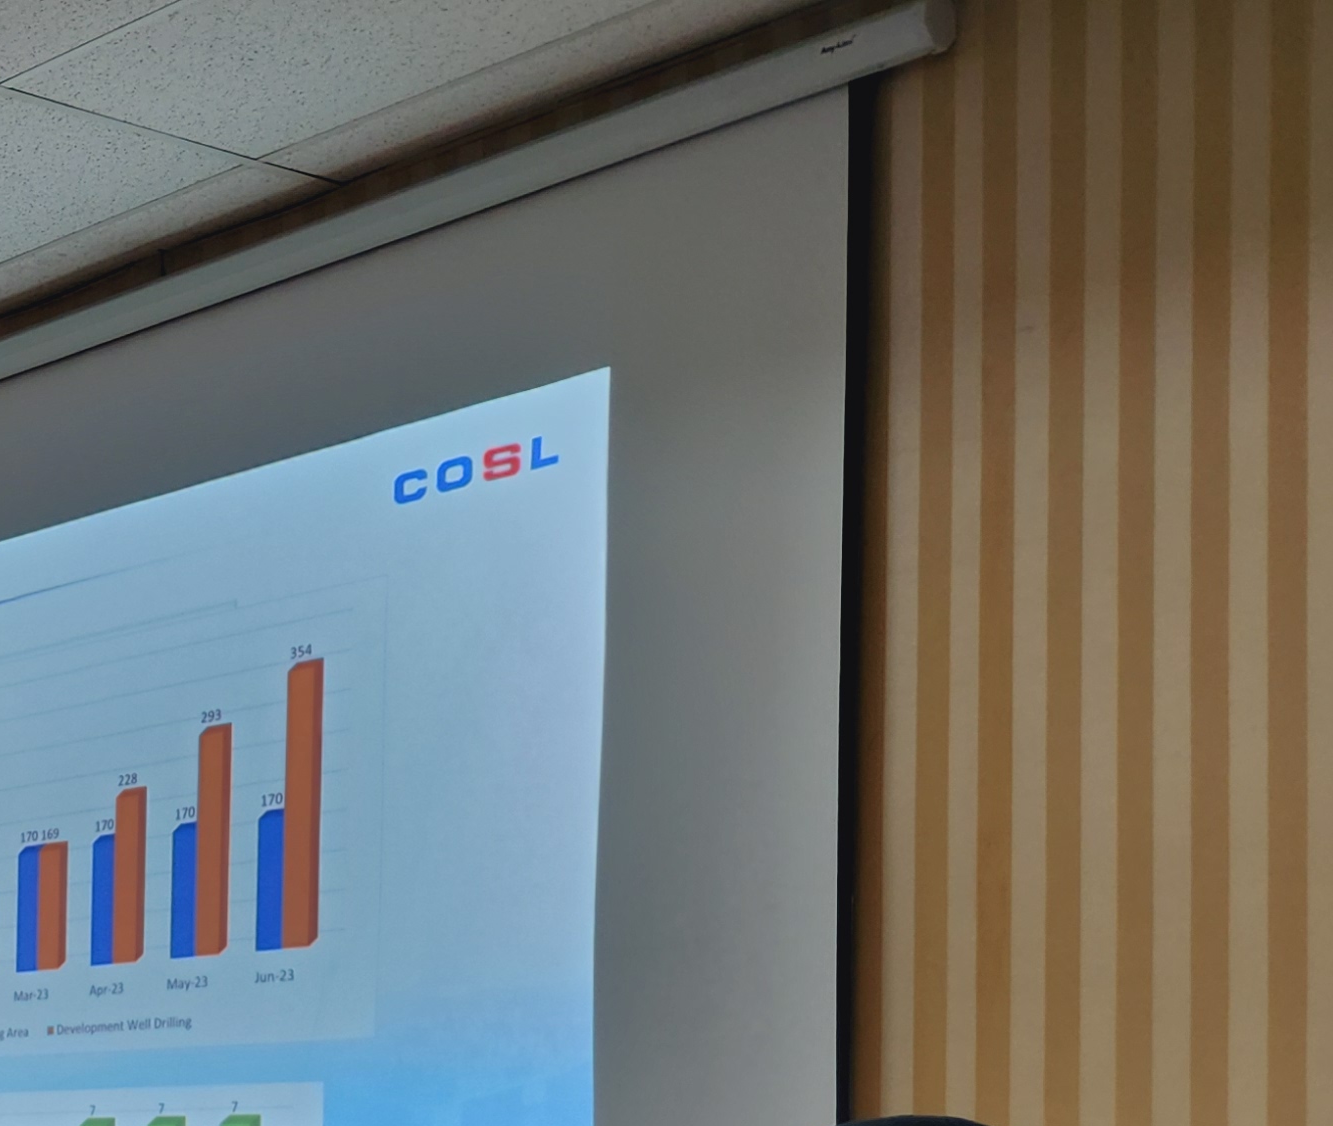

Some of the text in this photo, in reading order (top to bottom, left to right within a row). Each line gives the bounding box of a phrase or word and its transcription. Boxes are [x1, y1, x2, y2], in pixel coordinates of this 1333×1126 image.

[393, 436, 559, 504] COSL
[290, 644, 312, 659] 354
[201, 709, 222, 723] 293
[118, 773, 138, 786] 228
[261, 793, 283, 807] 170
[175, 806, 195, 820] 170
[95, 819, 114, 832] 170
[21, 831, 38, 843] 170
[41, 828, 60, 841] 169
[254, 969, 295, 984] Jun-23
[89, 982, 124, 997] Apr-23
[167, 976, 208, 992] May-23
[13, 989, 49, 1002] Mar-23
[7, 1028, 29, 1038] Area
[57, 1017, 192, 1035] Development Well Drilling
